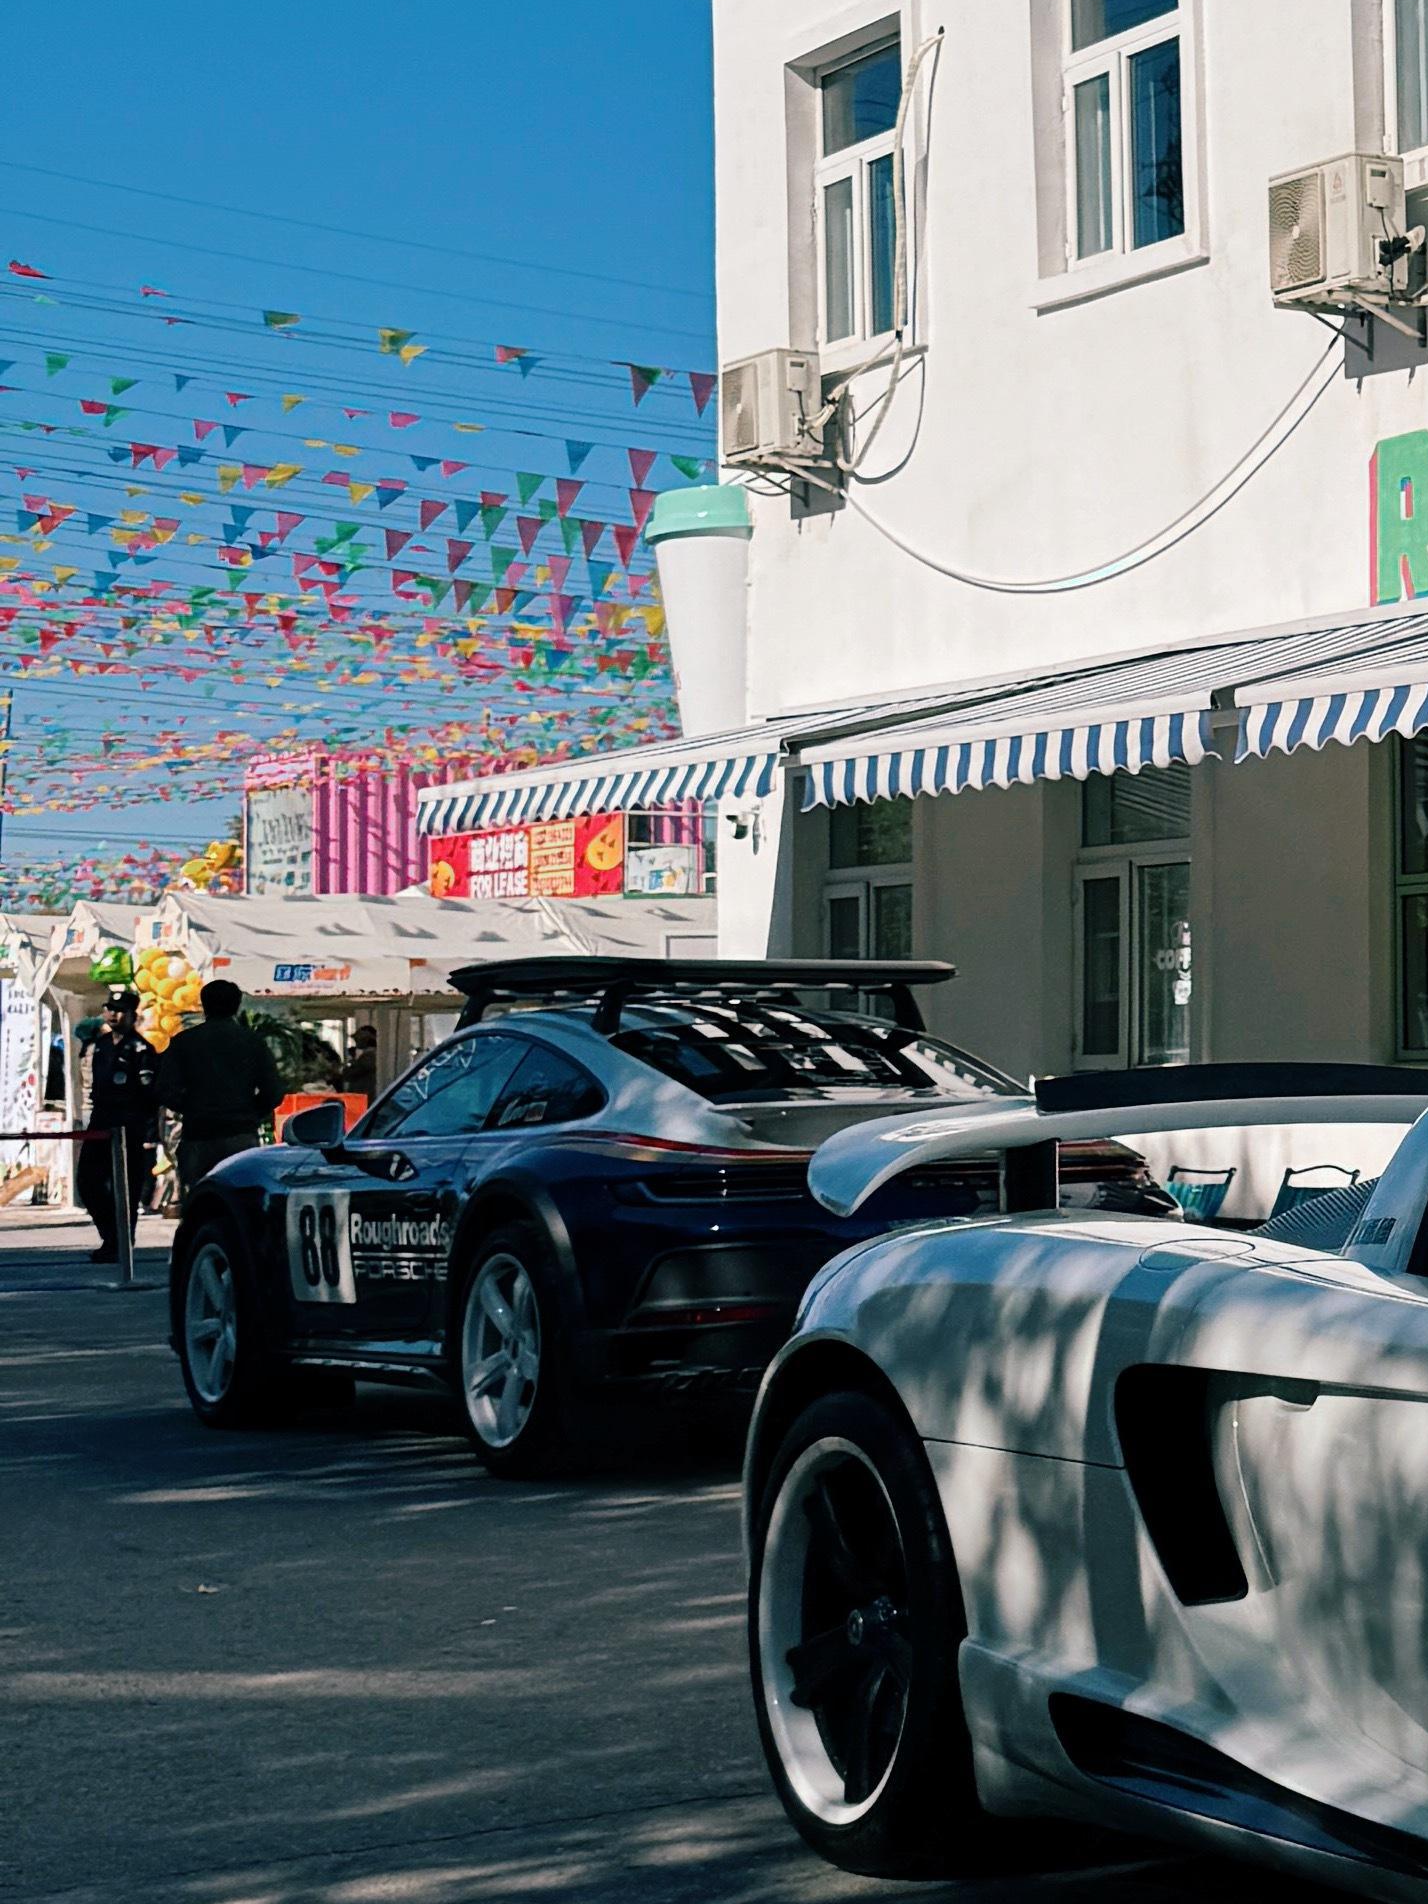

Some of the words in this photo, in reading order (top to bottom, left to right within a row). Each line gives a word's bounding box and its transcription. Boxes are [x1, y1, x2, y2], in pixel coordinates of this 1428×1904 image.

[470, 873, 492, 899] FOR
[494, 869, 529, 897] LEASE
[300, 1205, 340, 1287] 88
[350, 1212, 450, 1250] Roughroads
[353, 1260, 448, 1280] PORSCHE
